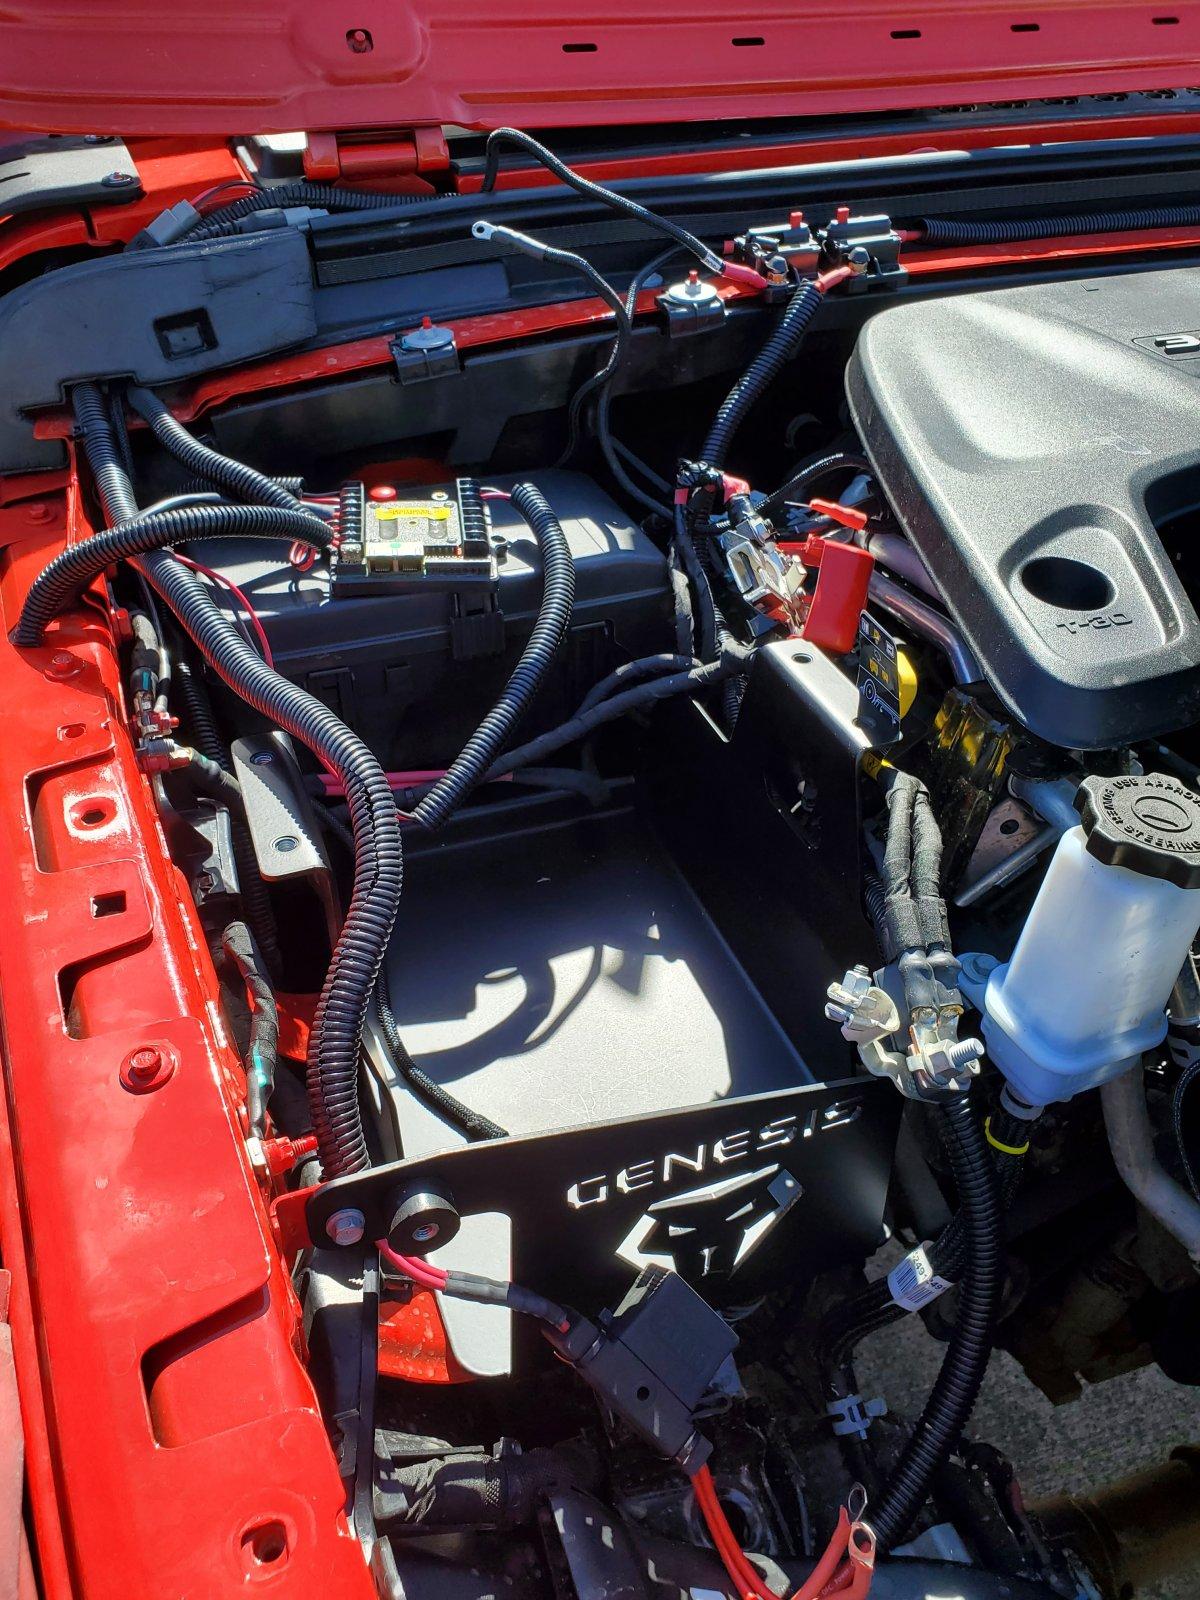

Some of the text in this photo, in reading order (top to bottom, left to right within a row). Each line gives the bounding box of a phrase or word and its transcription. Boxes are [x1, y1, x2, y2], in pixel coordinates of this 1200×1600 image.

[1102, 788, 1200, 851] POWER STEERING
[1113, 778, 1200, 807] USE APPROV
[567, 1096, 862, 1209] GENESIS
